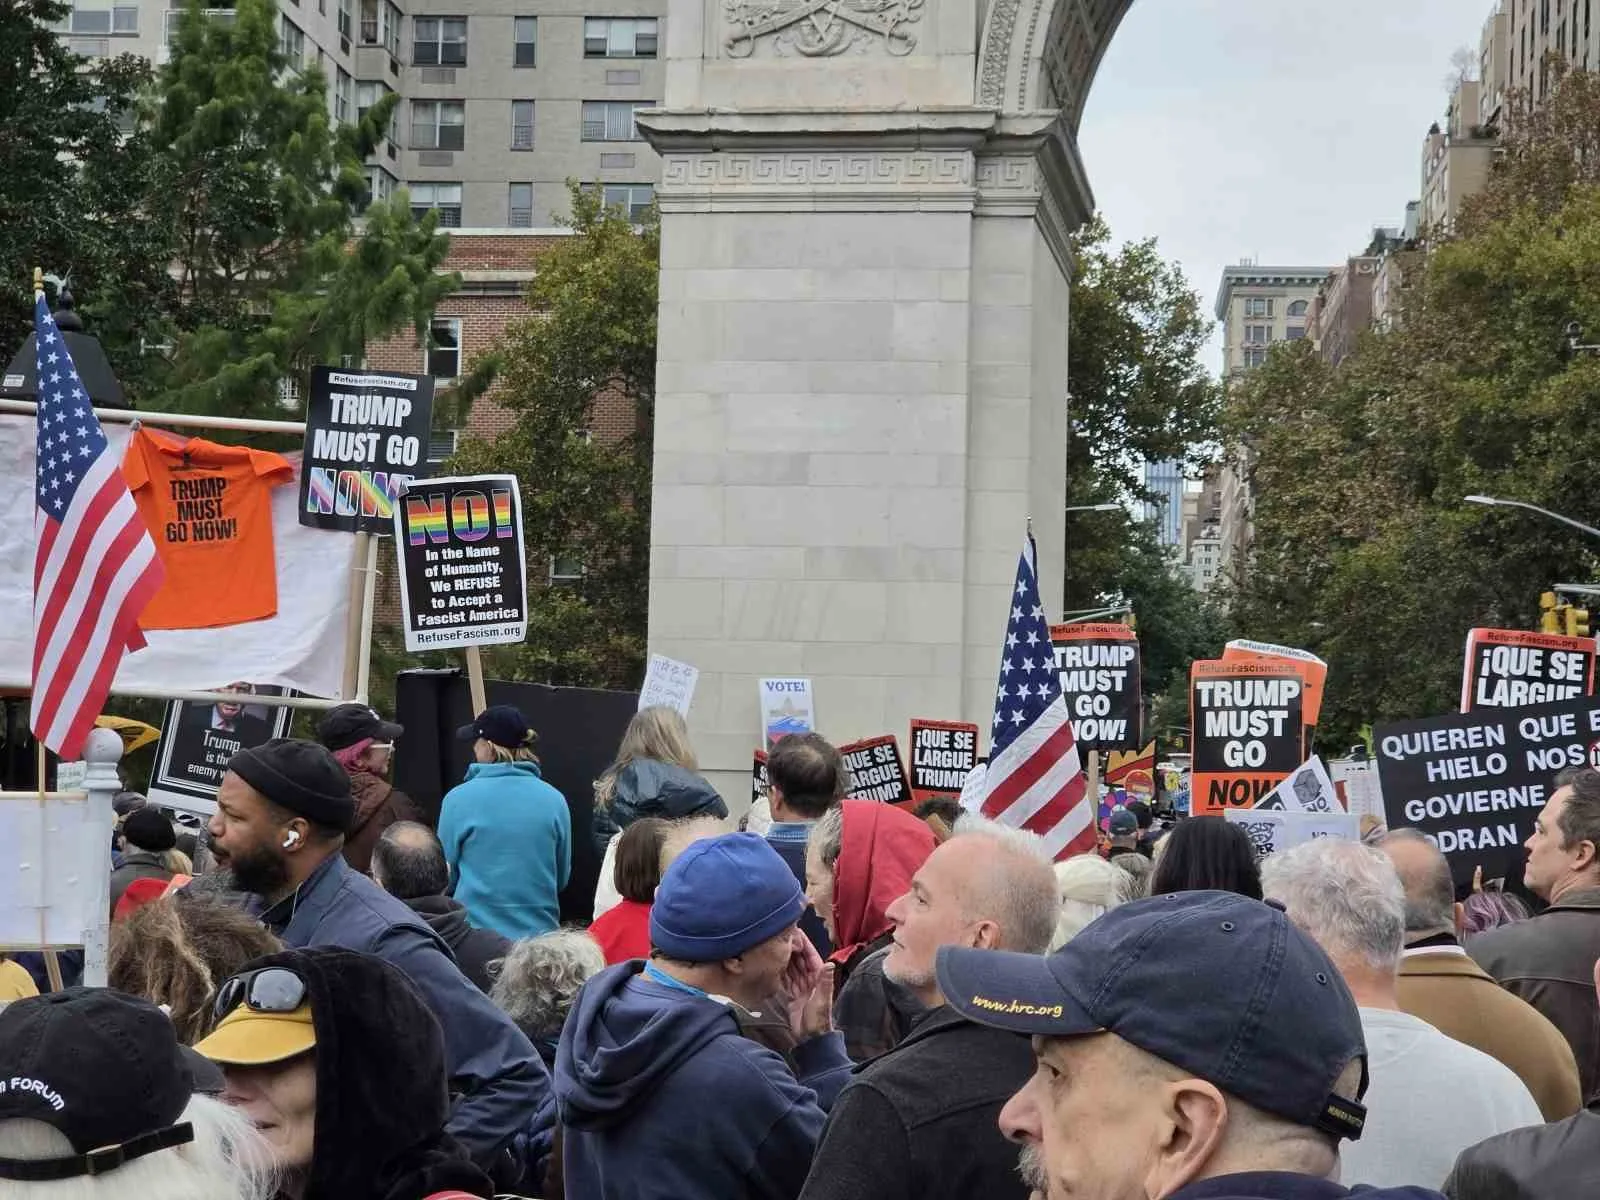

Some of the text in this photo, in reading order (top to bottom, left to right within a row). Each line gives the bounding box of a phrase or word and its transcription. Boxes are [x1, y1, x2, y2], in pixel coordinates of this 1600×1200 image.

[330, 393, 412, 428] TRUMP
[312, 429, 420, 466] MUST GO
[169, 477, 226, 500] TRUMP
[177, 499, 223, 521] MUST
[406, 488, 513, 546] NO!
[166, 518, 237, 542] GO NOW!
[425, 546, 500, 561] In the Name
[425, 564, 439, 578] of
[430, 576, 501, 593] We REFUSE
[431, 594, 504, 609] to Accept a
[418, 608, 519, 626] Fascist America
[418, 626, 521, 644] RefuseFascism.org
[1053, 646, 1135, 668] TRUMP
[1481, 646, 1585, 681] ¡QUE SE
[766, 681, 806, 692] VOTE!
[1059, 670, 1127, 692] MUST
[1476, 678, 1582, 707] LARGUE
[1075, 694, 1111, 716] GO
[1196, 680, 1300, 707] TRUMP
[1205, 710, 1288, 737] MUST
[203, 730, 240, 754] Trump
[954, 731, 974, 750] SE
[1381, 724, 1506, 760] QUIEREN
[1519, 713, 1577, 741] QUE
[205, 751, 215, 762] is
[842, 745, 896, 772] QUE SE
[914, 749, 973, 770] LARGUE
[1224, 740, 1266, 768] GO
[1426, 753, 1507, 783] HIELO
[1527, 744, 1585, 772] NOS
[187, 763, 218, 780] enemy
[847, 763, 902, 788] ARGUE
[916, 768, 967, 788] TRUMP
[1405, 784, 1546, 822] GOVIERNE
[1424, 824, 1518, 853] DRAN
[972, 995, 1063, 1018] www.hrc.org
[11, 1077, 65, 1111] FORUM
